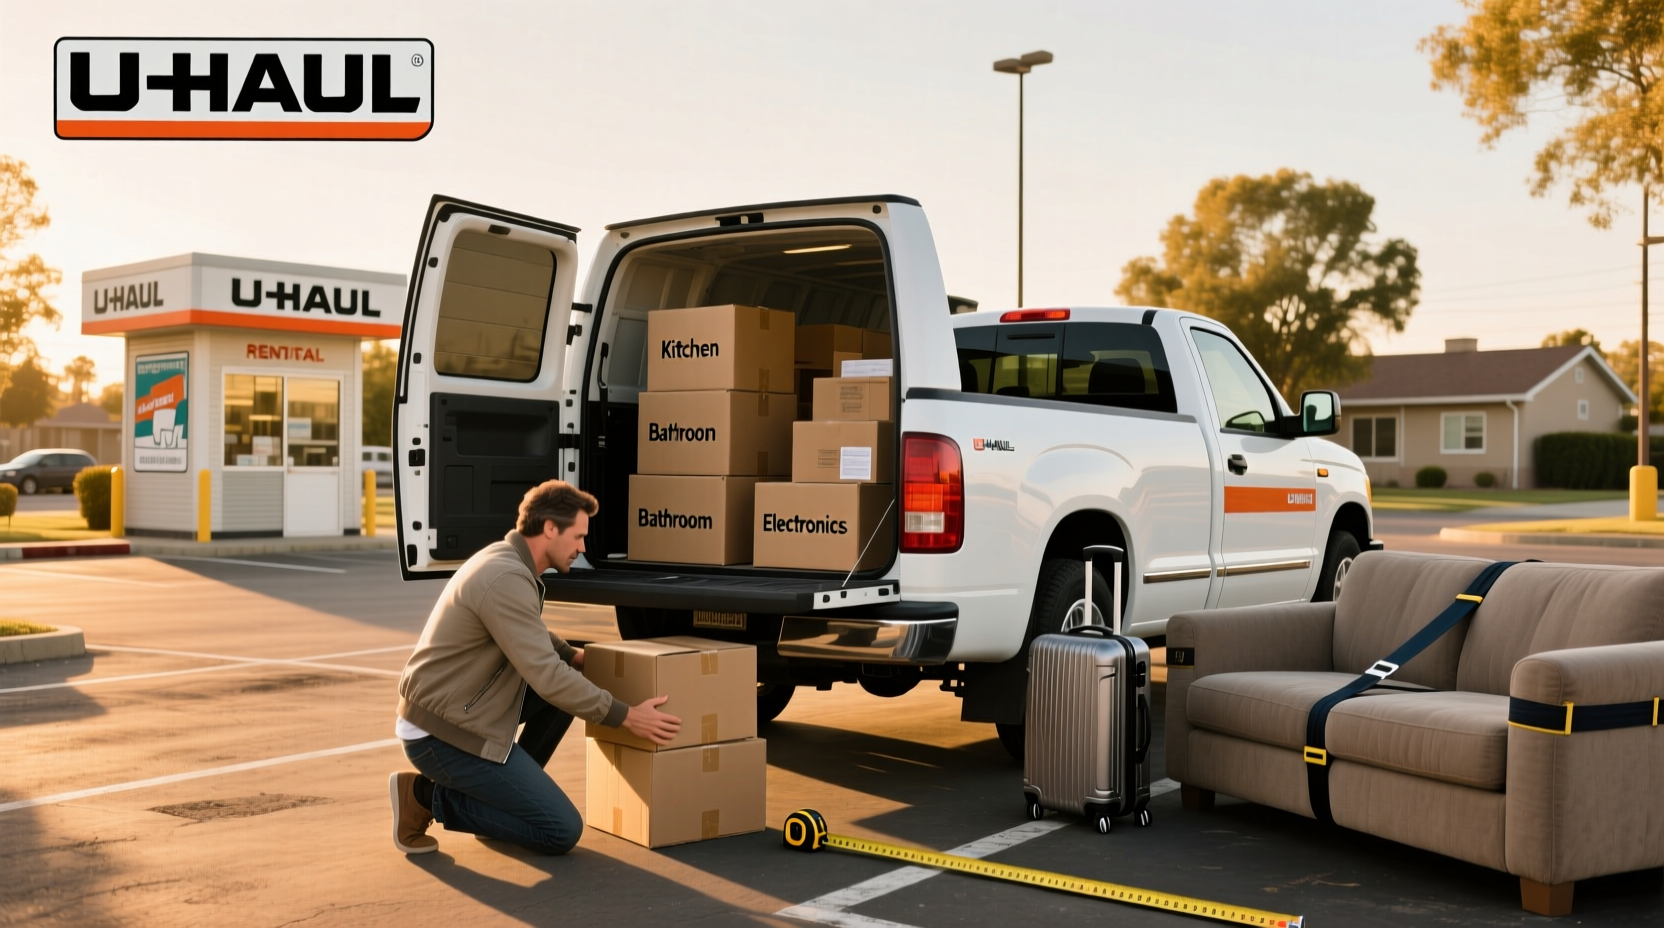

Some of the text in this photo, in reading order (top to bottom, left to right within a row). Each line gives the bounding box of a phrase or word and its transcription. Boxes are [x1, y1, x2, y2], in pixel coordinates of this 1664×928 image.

[93, 281, 164, 315] U-HAUL
[231, 277, 382, 318] U-HAUL
[661, 338, 719, 360] Kitchen
[638, 508, 713, 530] Bathroom
[762, 513, 848, 535] Electronics
